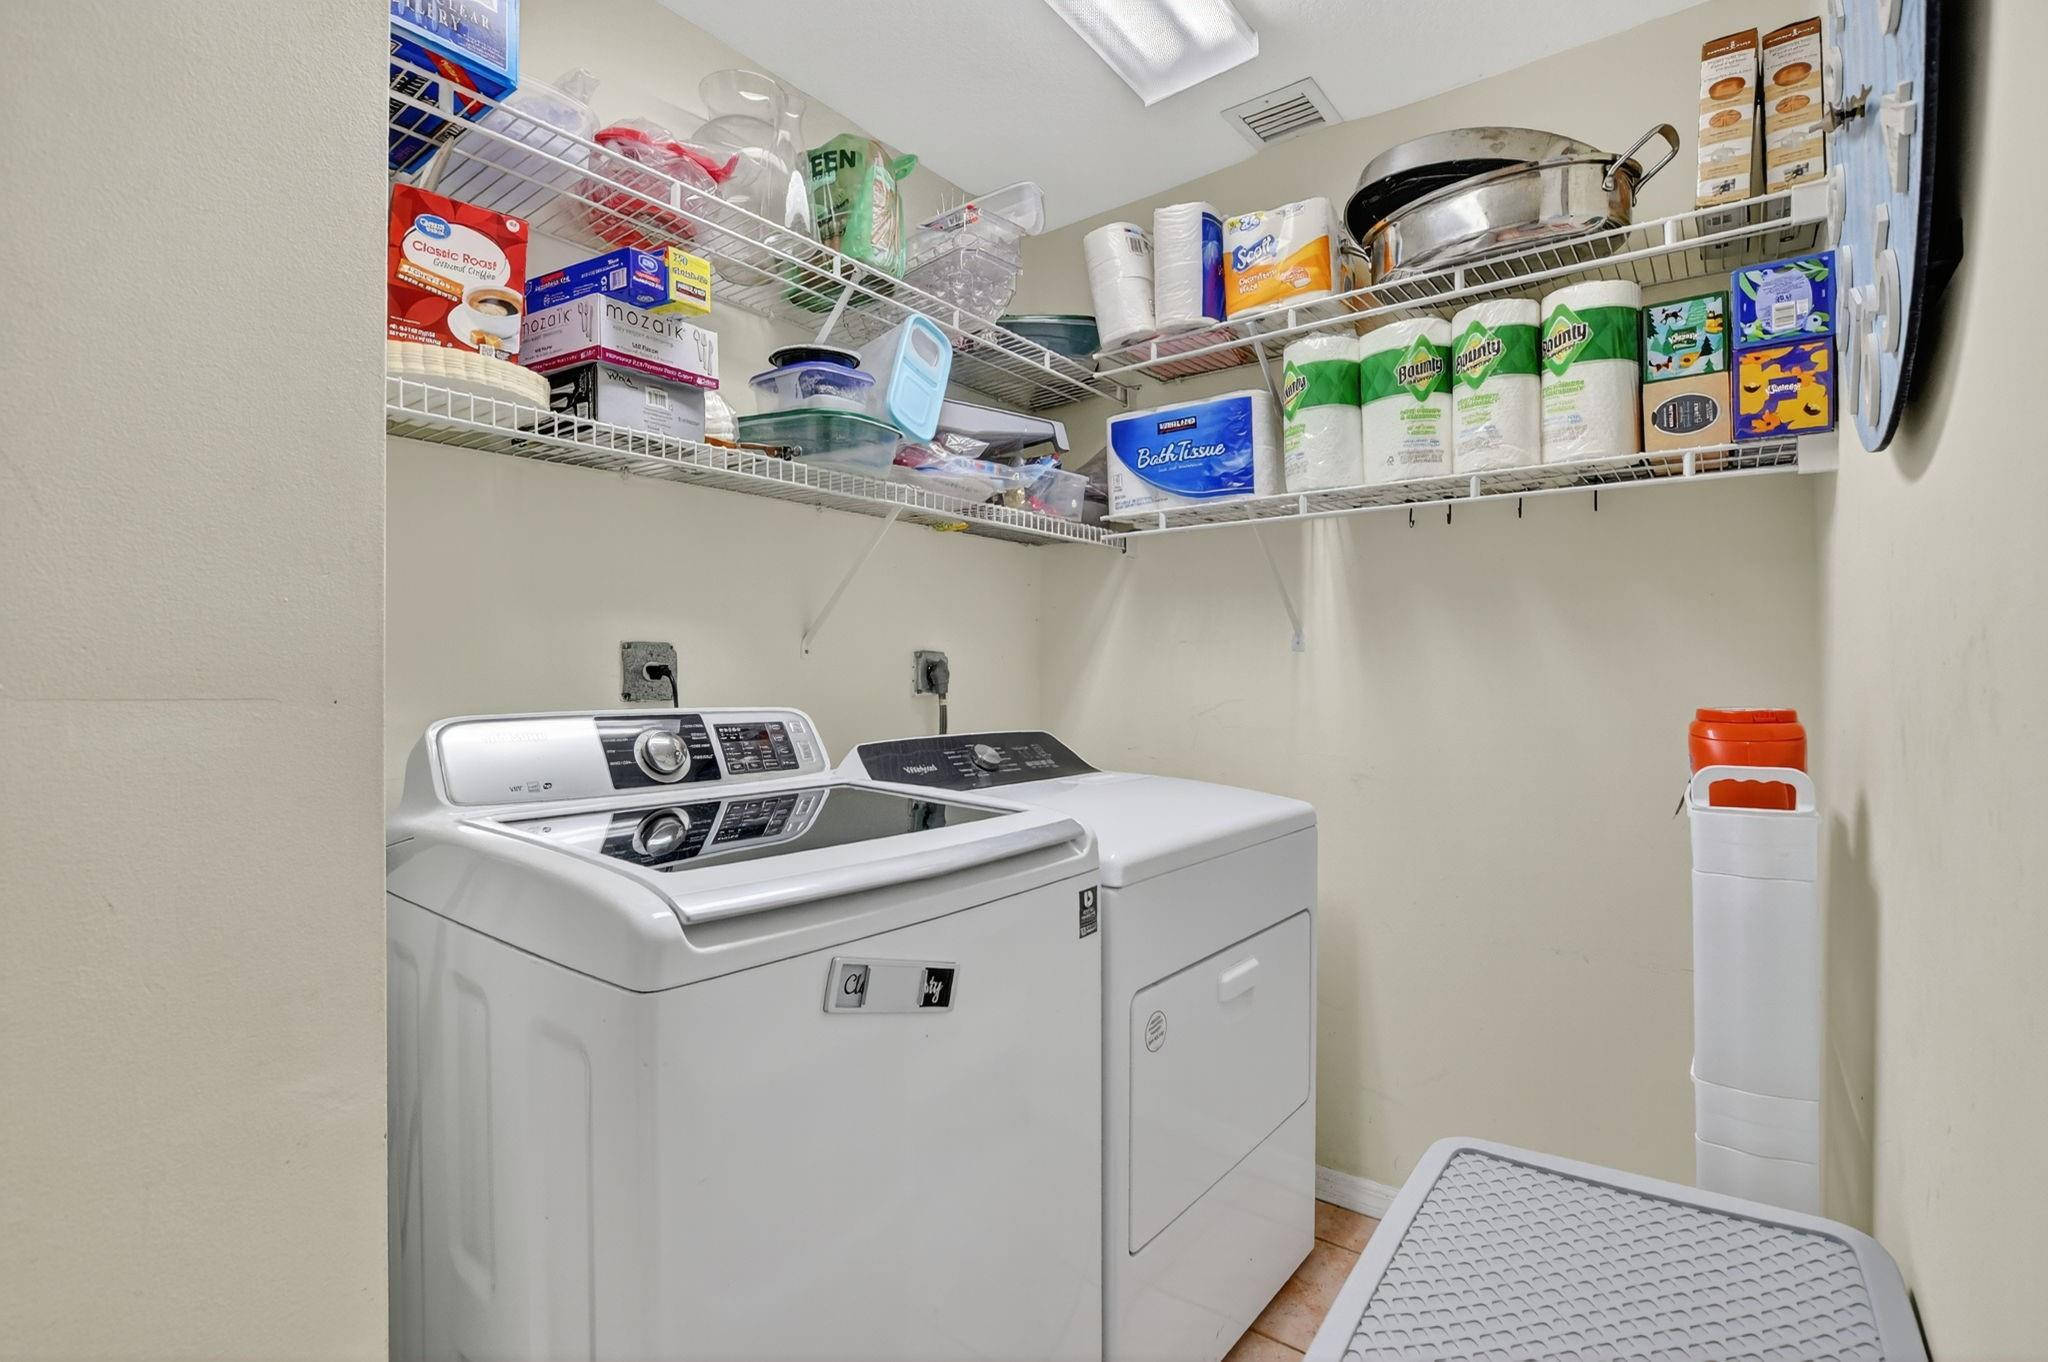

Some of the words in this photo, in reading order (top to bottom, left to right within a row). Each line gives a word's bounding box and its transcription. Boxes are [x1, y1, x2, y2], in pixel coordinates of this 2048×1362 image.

[810, 149, 856, 178] EEN
[412, 240, 459, 262] Classic
[462, 253, 498, 271] Roast
[1237, 236, 1274, 269] Scott
[1398, 356, 1443, 382] Bounty
[1456, 338, 1502, 374] Bounty
[1137, 442, 1178, 469] Bath
[1178, 440, 1226, 462] Tissue
